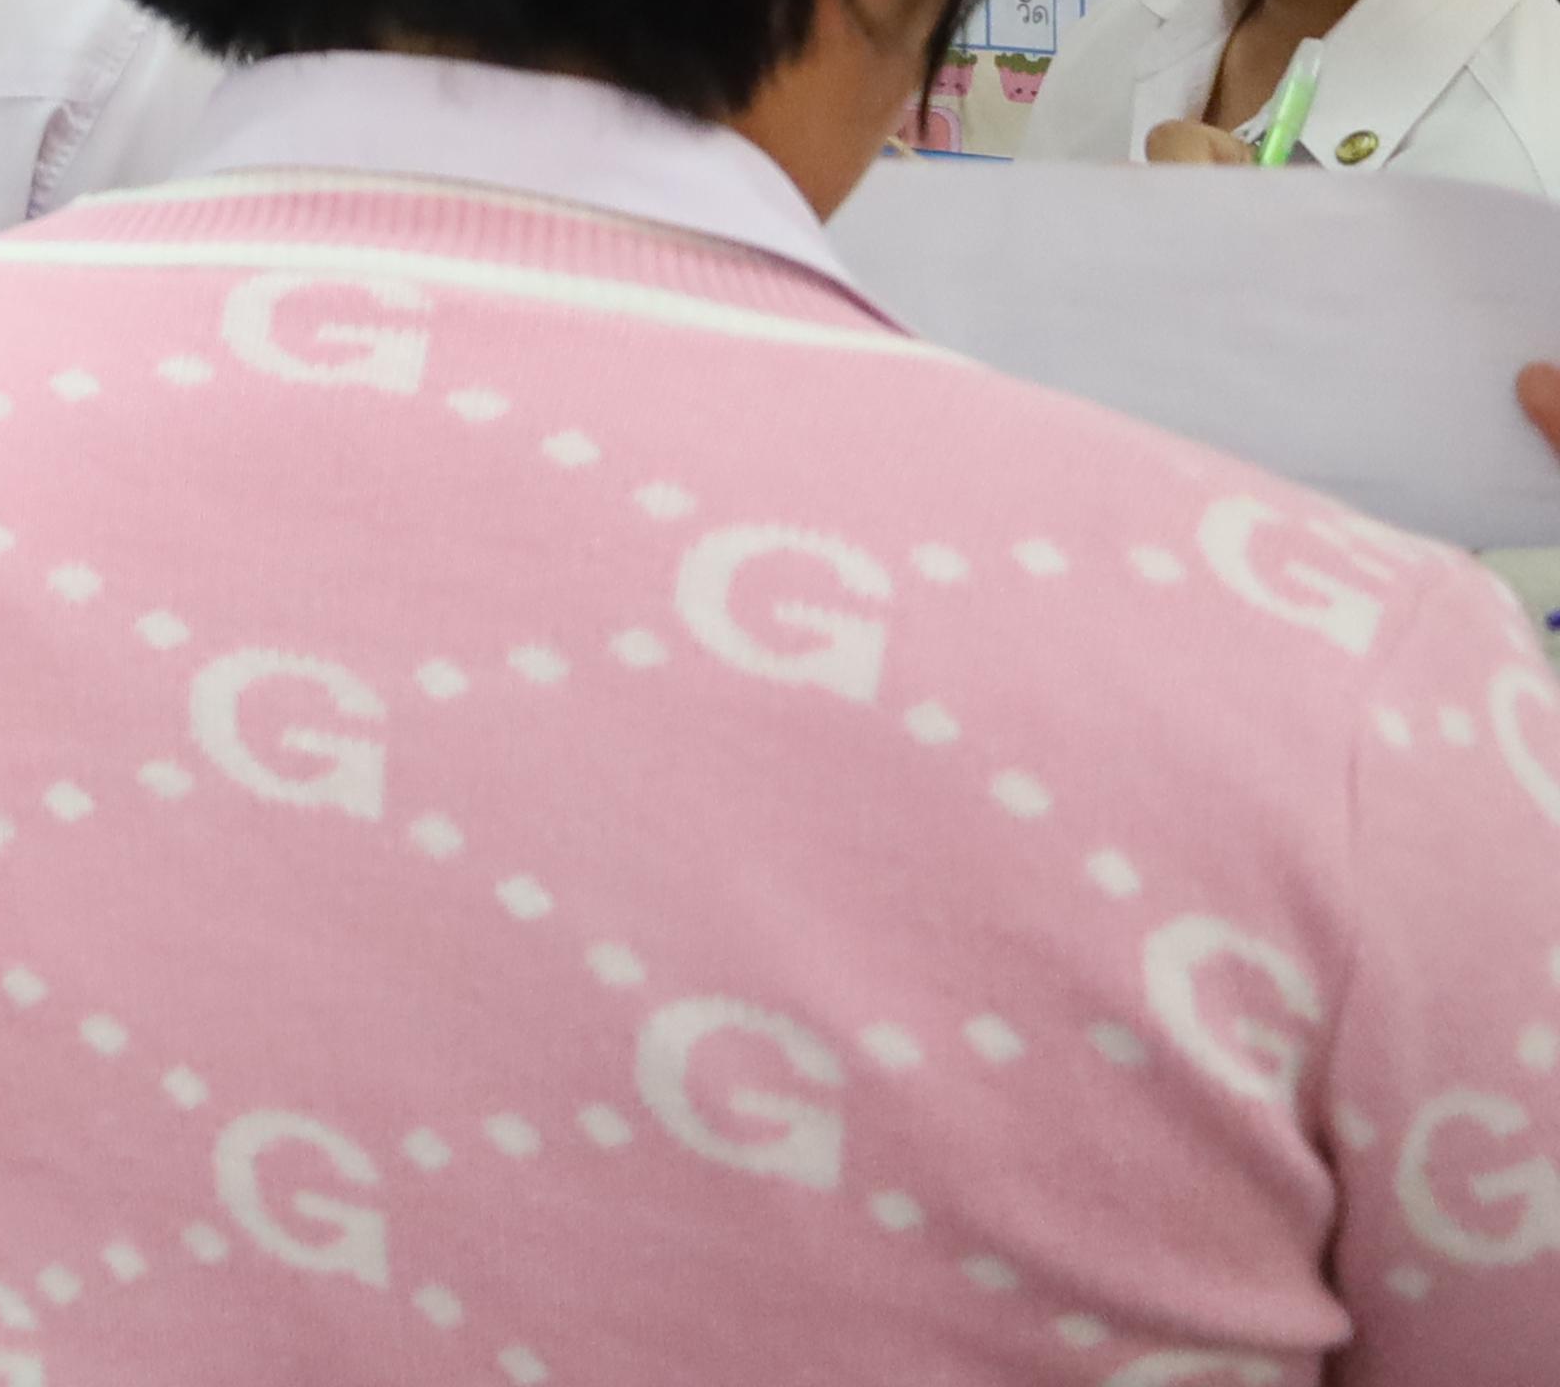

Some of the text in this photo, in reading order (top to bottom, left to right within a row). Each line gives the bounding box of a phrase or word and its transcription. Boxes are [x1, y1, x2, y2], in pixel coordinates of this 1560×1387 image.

[221, 271, 436, 396] G
[673, 522, 893, 704] G
[189, 647, 388, 822] G
[633, 994, 846, 1192] G
[1393, 1085, 1560, 1265] G
[213, 1107, 392, 1292] G
